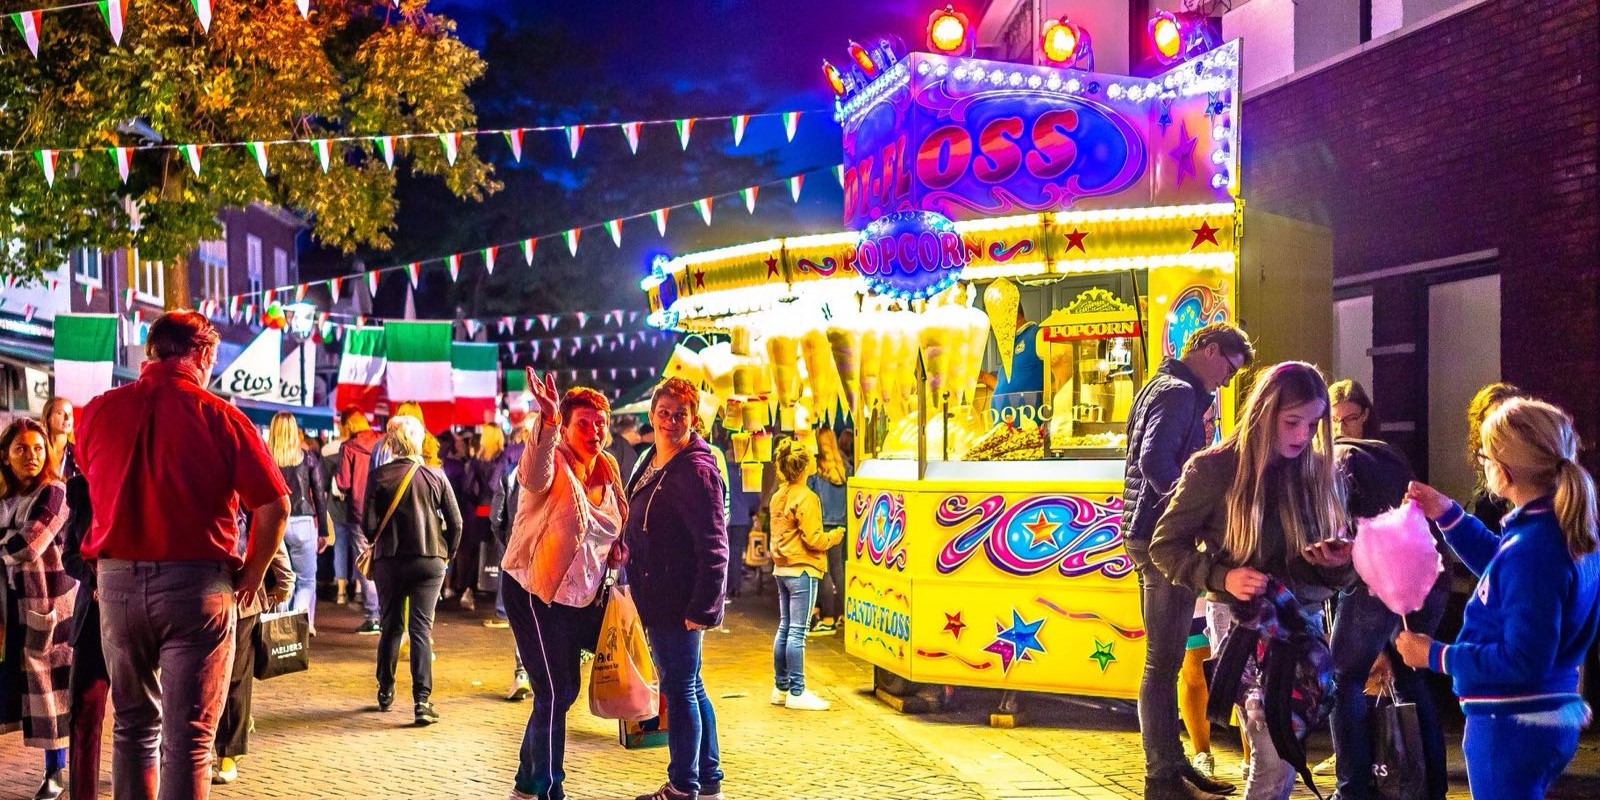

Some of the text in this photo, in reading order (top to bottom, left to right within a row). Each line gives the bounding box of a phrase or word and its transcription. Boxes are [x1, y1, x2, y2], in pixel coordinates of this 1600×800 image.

[841, 231, 984, 275] POPCORN
[1049, 321, 1135, 338] POPCORN
[229, 369, 273, 394] Etos
[847, 596, 910, 642] CANDY-FLOSS
[271, 642, 303, 656] MEIJERS
